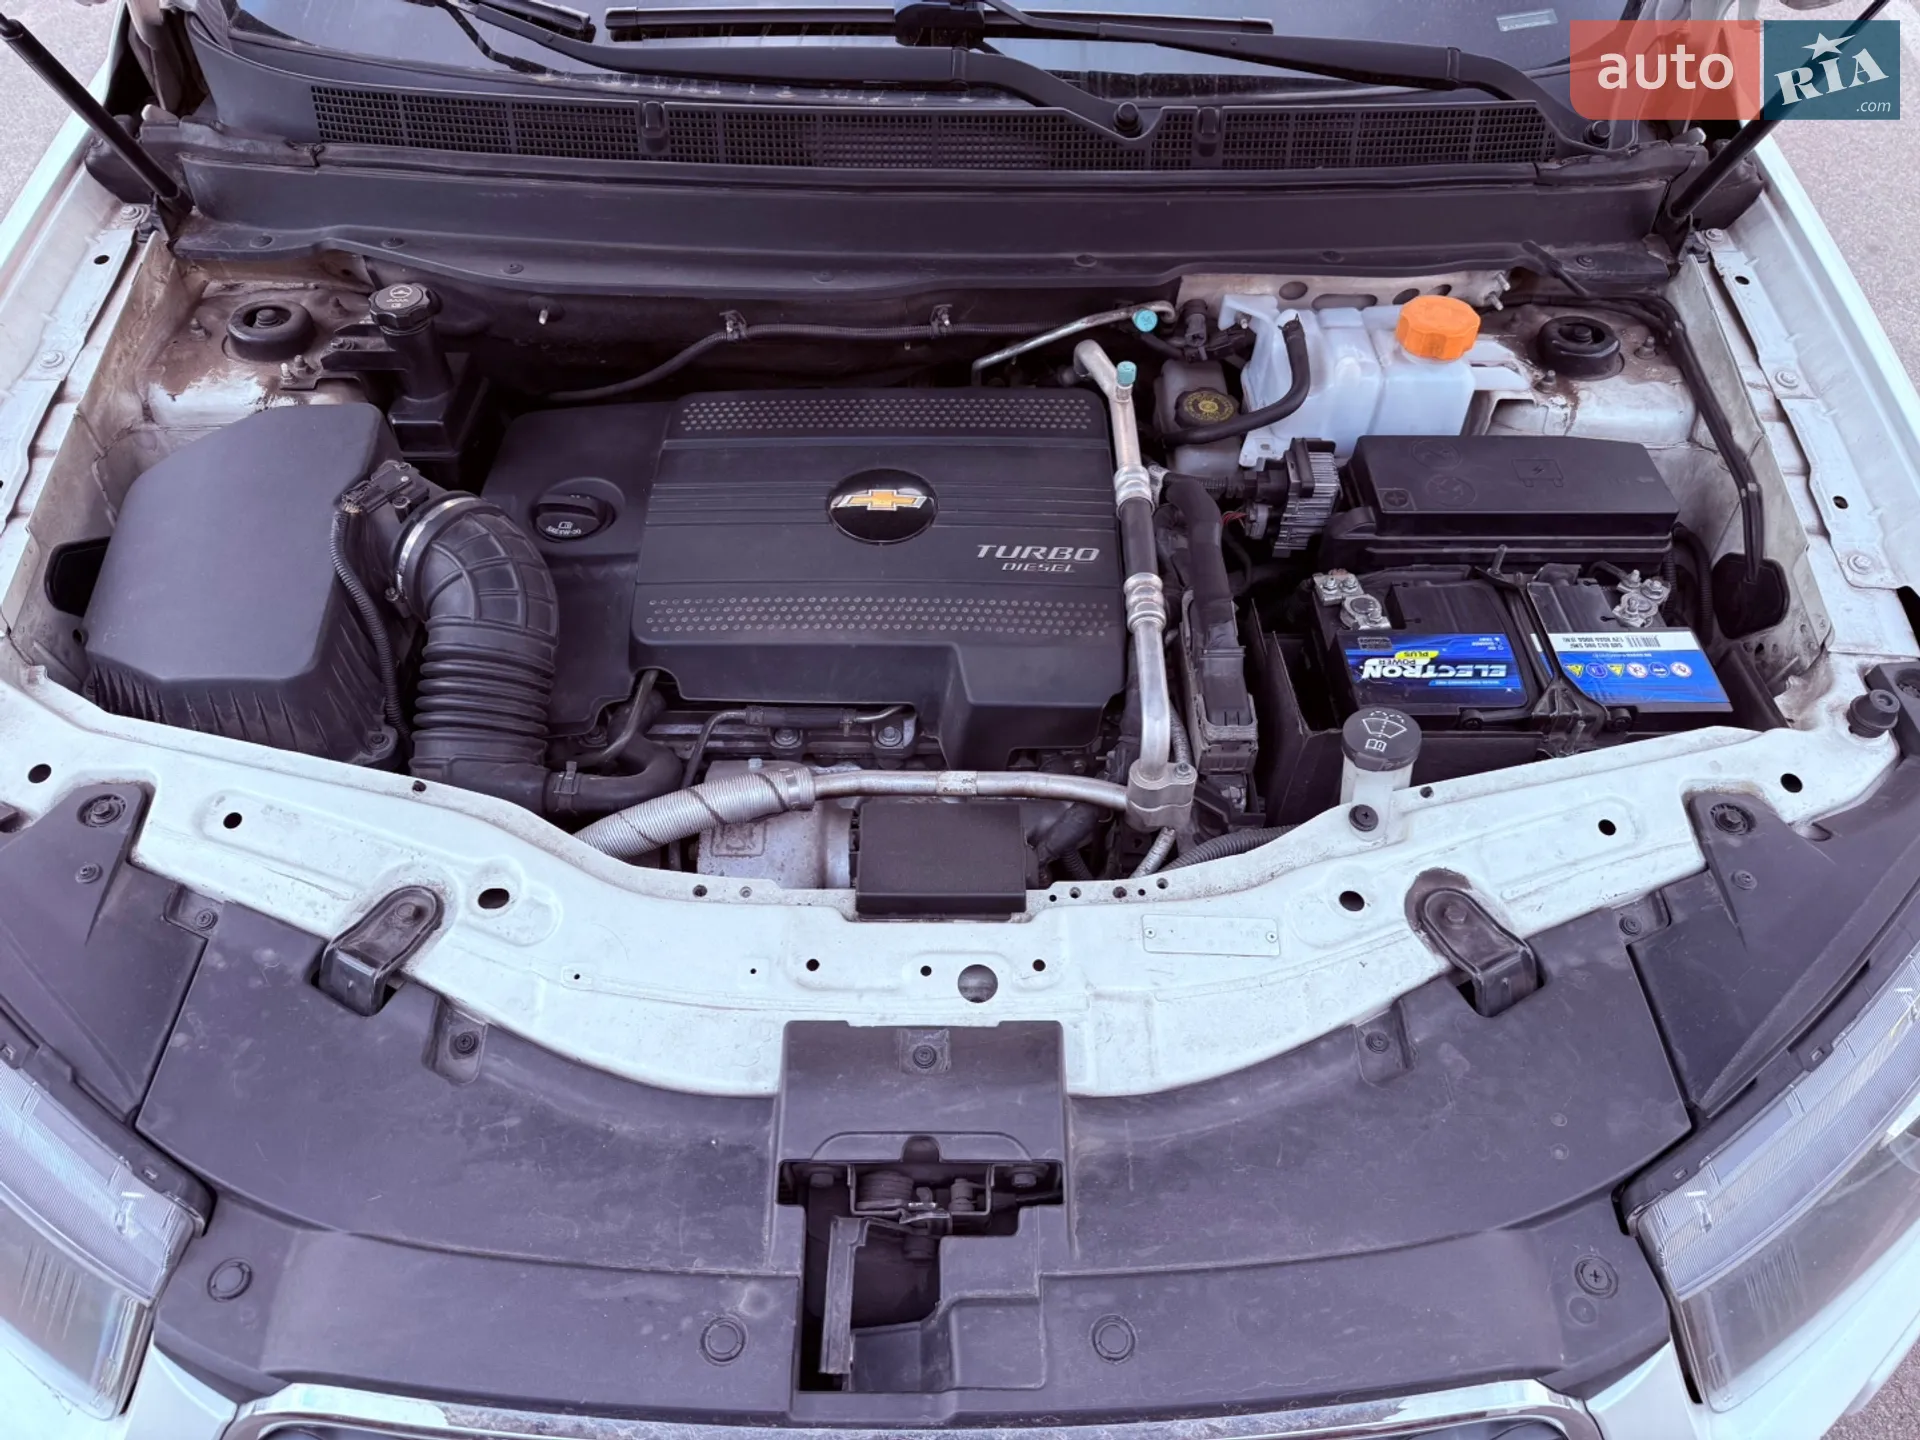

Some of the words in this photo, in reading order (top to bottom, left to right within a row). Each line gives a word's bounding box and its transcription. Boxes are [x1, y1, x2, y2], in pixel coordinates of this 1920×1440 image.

[977, 545, 1100, 561] TURBO
[1002, 563, 1076, 573] DIESEL
[1379, 658, 1416, 666] POWER
[1361, 664, 1507, 679] ELECTRON
